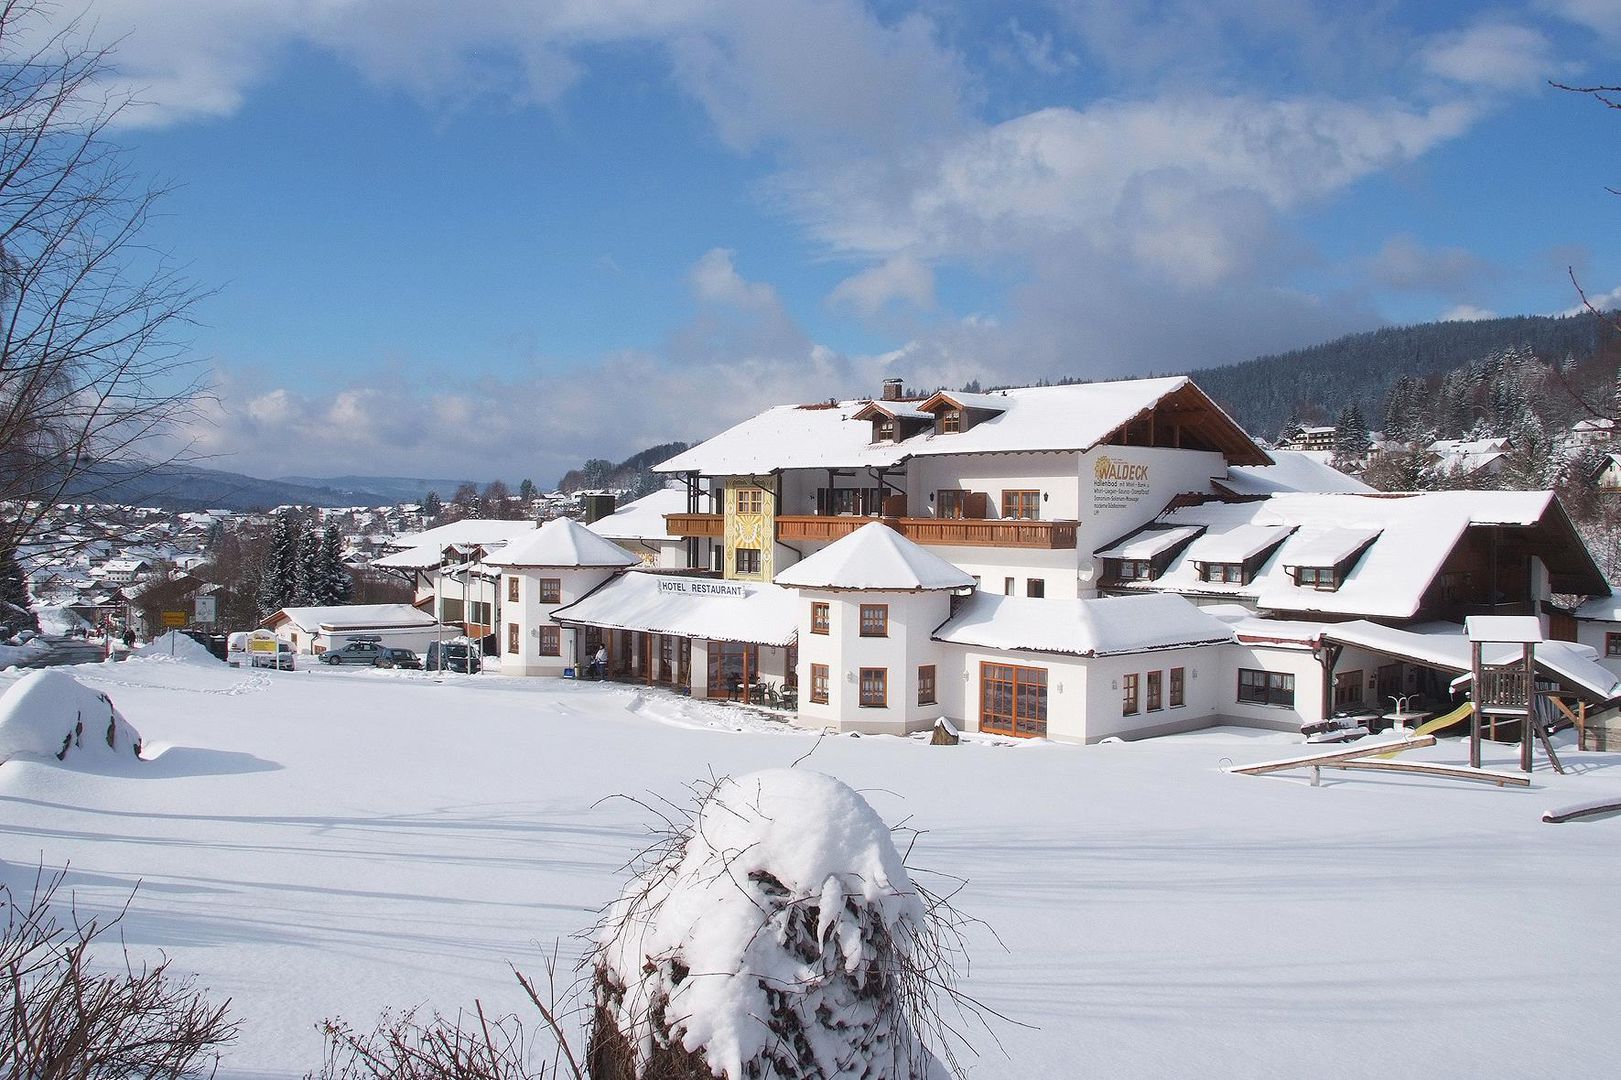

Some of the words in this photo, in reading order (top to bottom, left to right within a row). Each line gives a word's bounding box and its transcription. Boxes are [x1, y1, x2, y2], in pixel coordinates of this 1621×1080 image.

[1099, 464, 1148, 480] WALDECK
[662, 582, 686, 592] HOTEL
[691, 583, 742, 596] RESTAURANT
